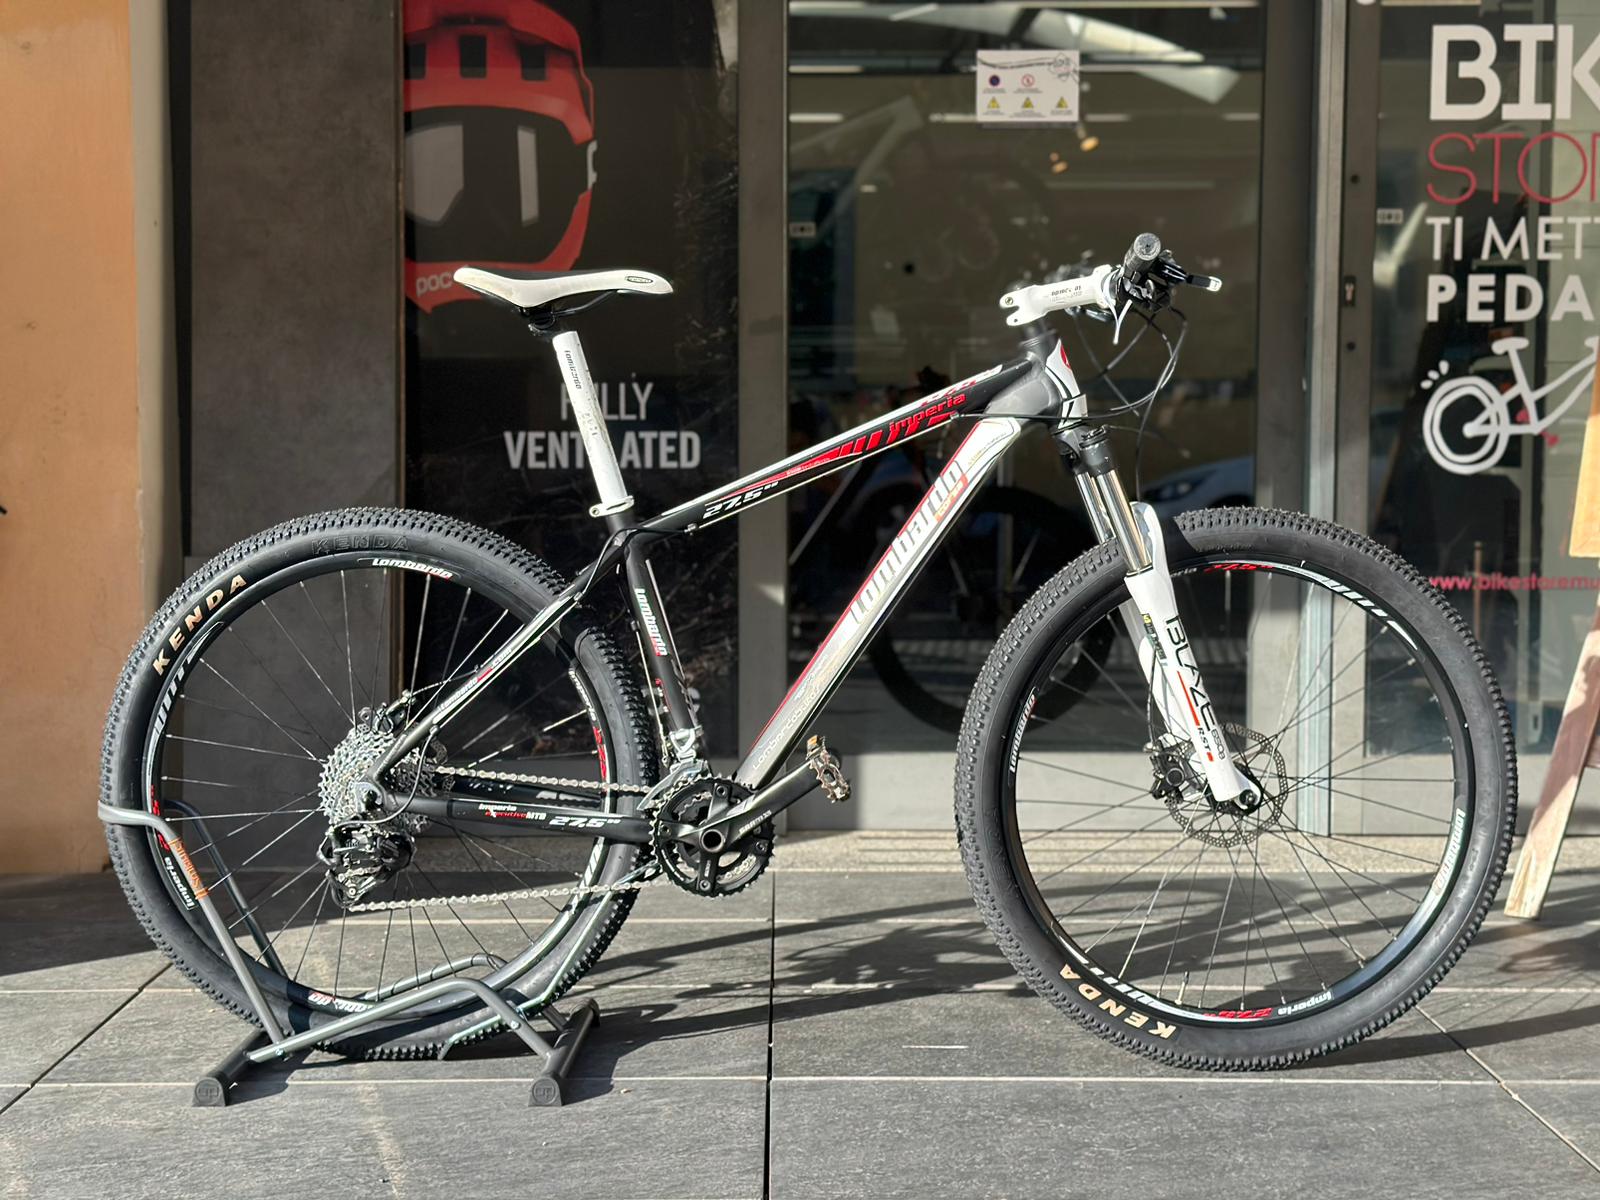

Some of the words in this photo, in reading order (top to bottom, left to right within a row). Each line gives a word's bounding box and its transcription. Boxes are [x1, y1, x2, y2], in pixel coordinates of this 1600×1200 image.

[1429, 24, 1600, 121] BIK
[1427, 132, 1600, 204] STO
[1426, 217, 1463, 261] TI
[1426, 274, 1595, 322] PEDA
[561, 382, 653, 421] FLLY
[504, 431, 701, 469] VENTATED
[311, 535, 409, 555] KENDA
[152, 574, 247, 676] KENDA
[1165, 616, 1215, 731] BLAZE
[1197, 727, 1211, 752] RST
[1059, 964, 1177, 1039] KENDA
